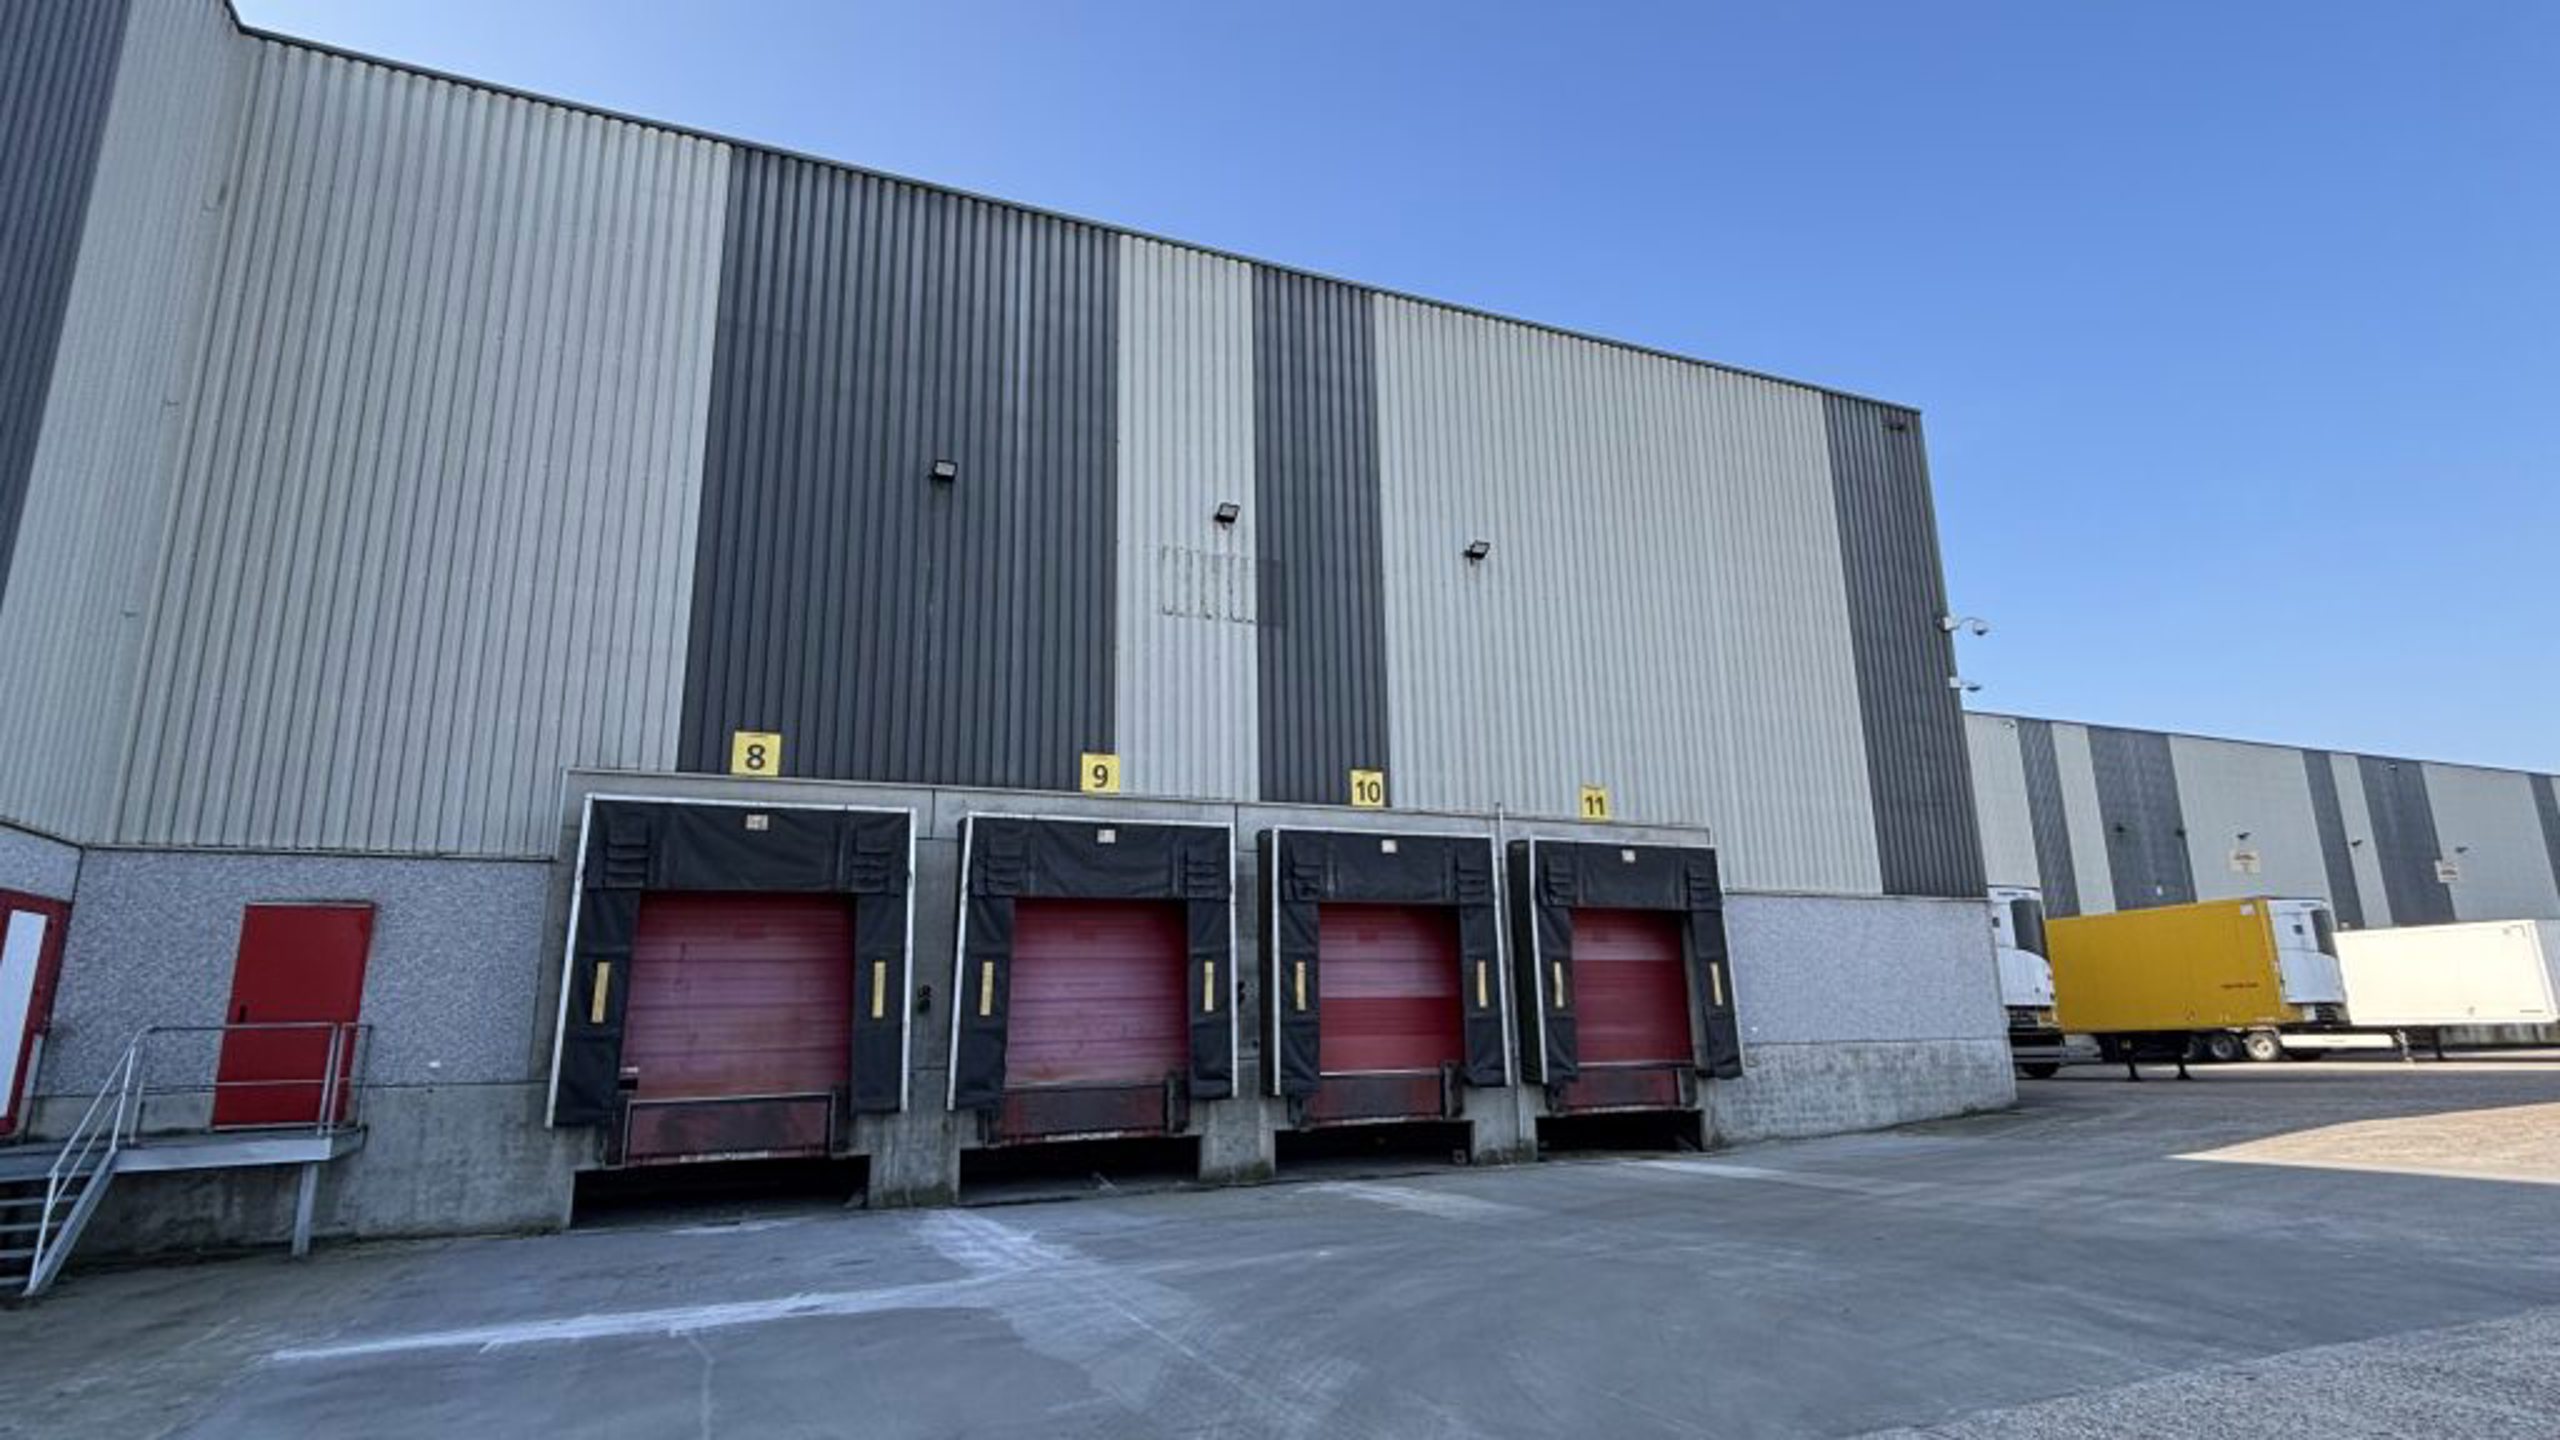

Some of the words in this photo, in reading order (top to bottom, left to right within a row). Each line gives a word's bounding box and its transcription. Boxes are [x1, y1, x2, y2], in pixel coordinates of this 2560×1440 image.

[746, 744, 766, 770] 8
[1093, 764, 1108, 788] 9
[1355, 780, 1380, 803] 10
[1585, 795, 1604, 816] 11
